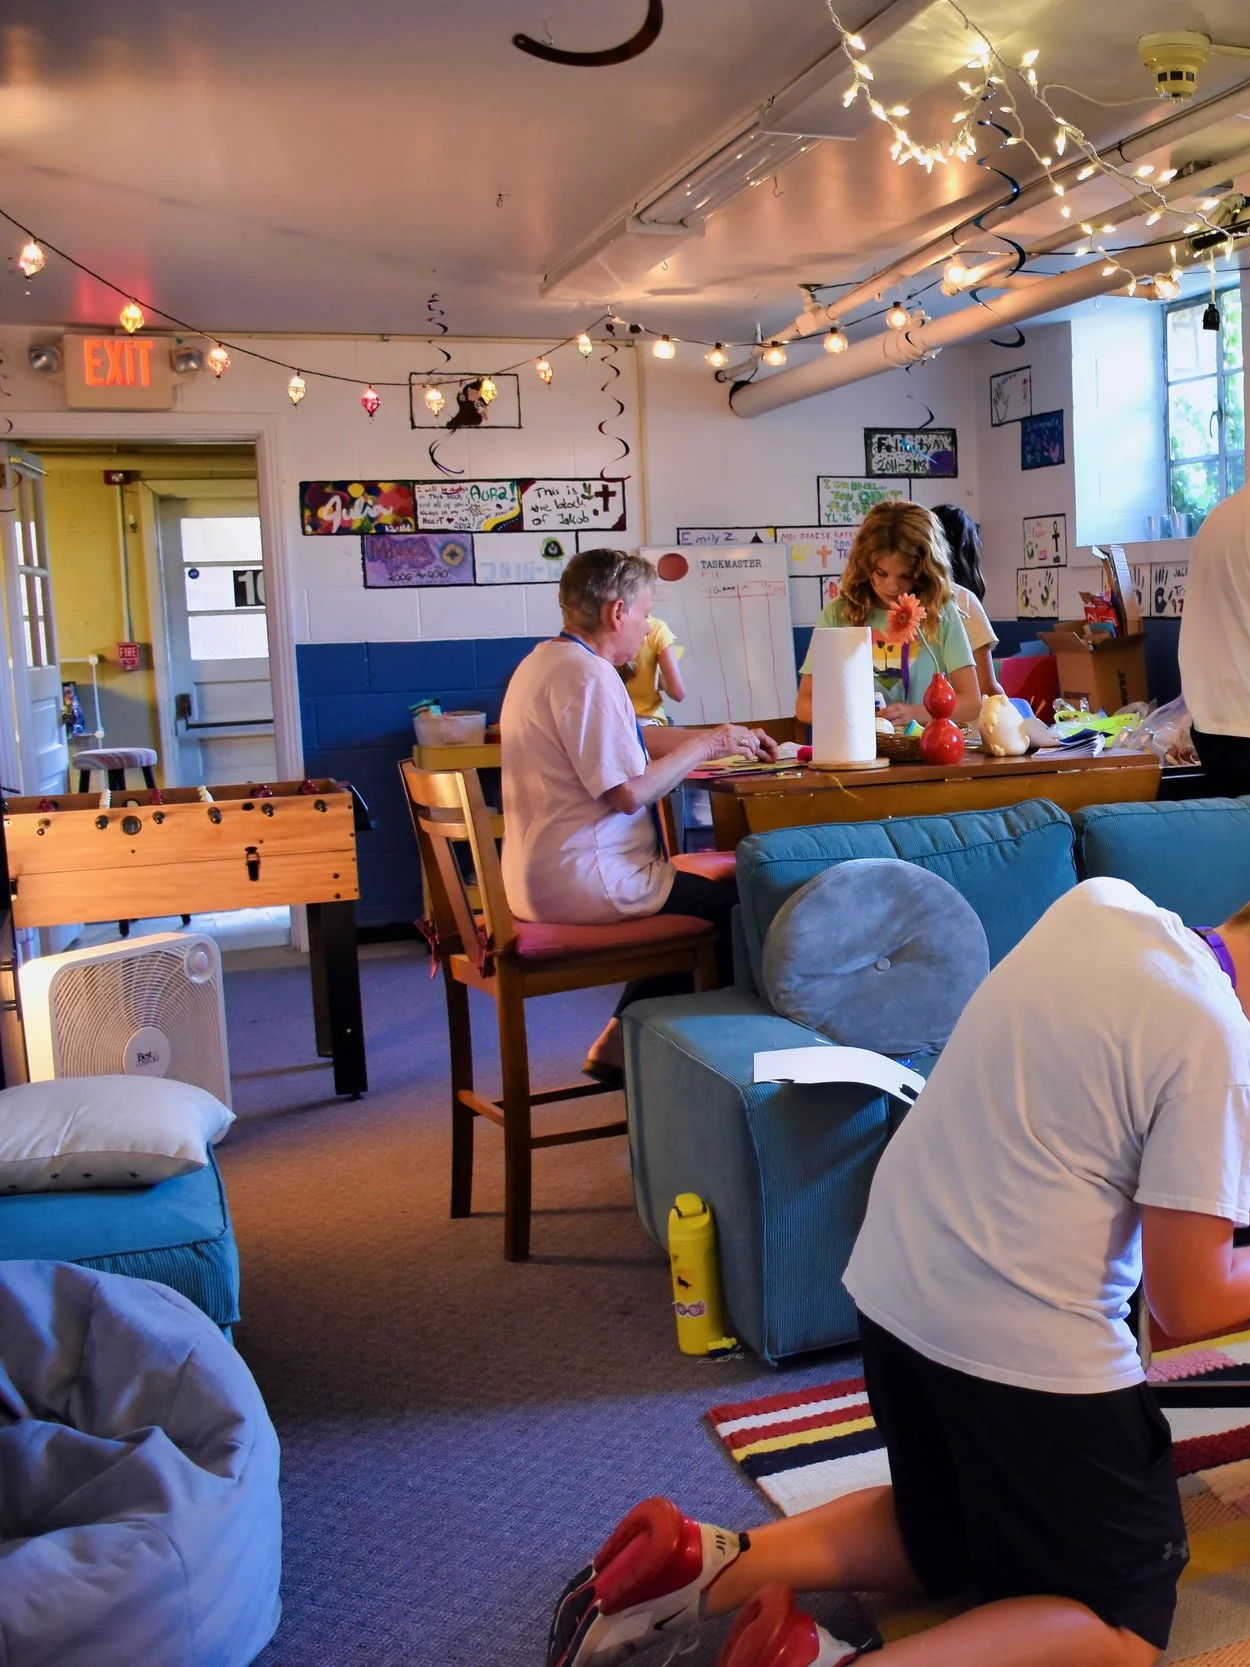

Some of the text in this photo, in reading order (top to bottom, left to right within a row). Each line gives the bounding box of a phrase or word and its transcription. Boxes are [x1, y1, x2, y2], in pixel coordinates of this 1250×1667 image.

[84, 339, 154, 386] EXIT
[534, 485, 578, 499] This is
[532, 513, 550, 526] of
[681, 532, 719, 545] Emily
[701, 560, 761, 569] TASKMASTER
[119, 647, 138, 658] FIRE
